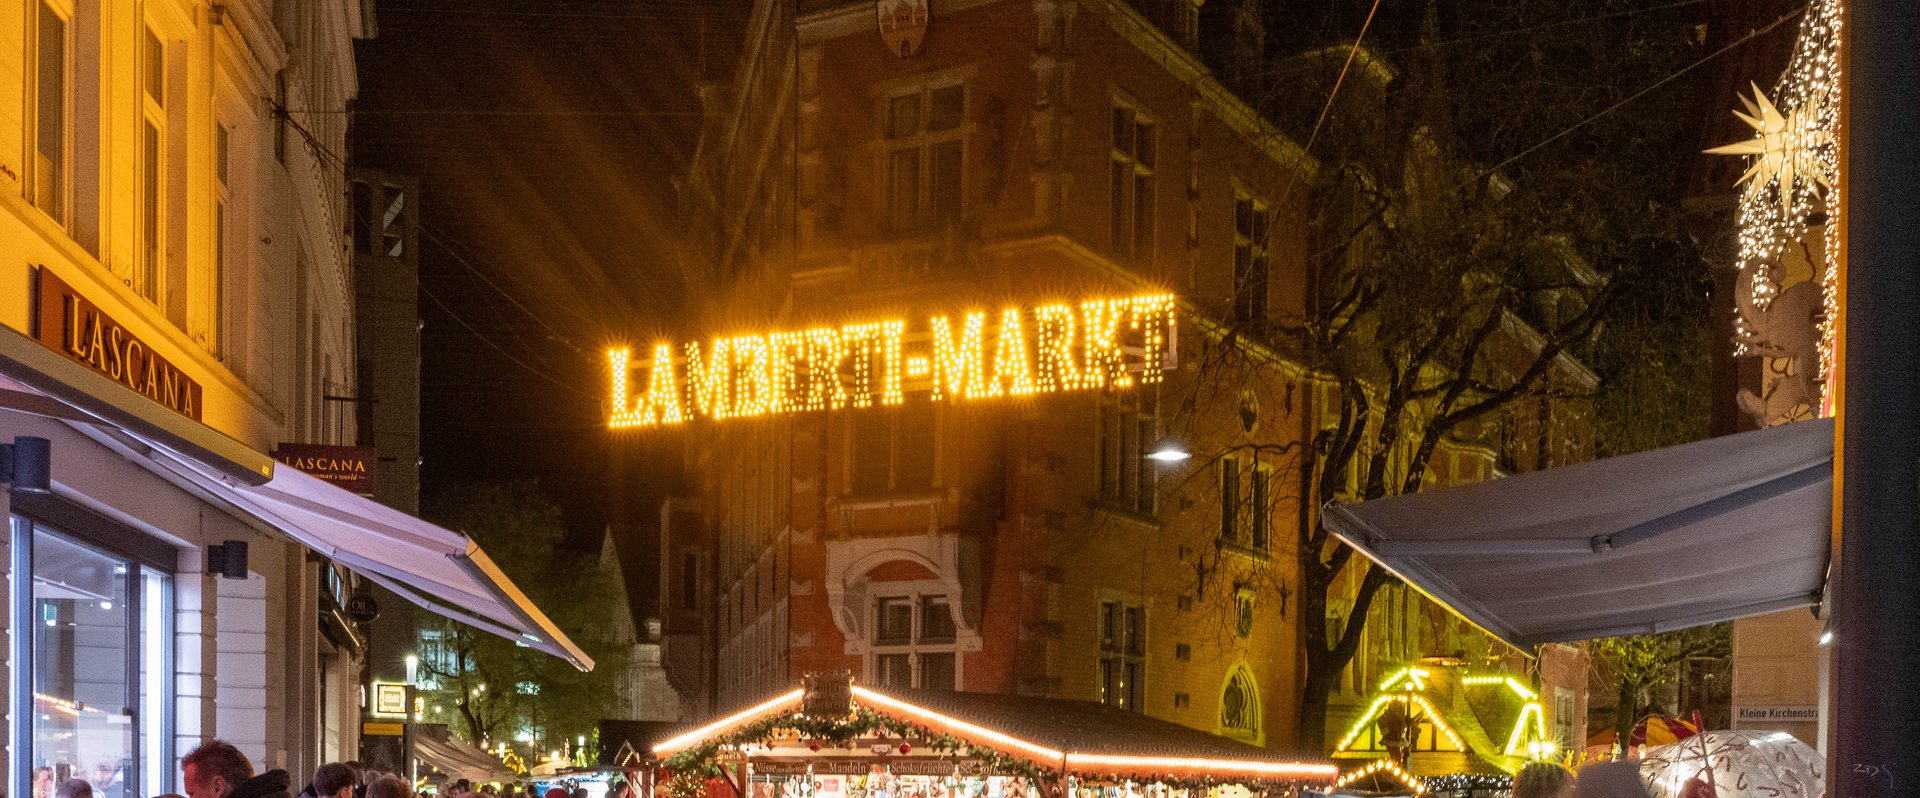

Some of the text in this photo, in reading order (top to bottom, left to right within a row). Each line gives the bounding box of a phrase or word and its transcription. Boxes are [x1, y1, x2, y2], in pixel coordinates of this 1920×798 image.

[72, 294, 193, 417] LASCANA
[609, 293, 1174, 427] LAMBERTI-MARKT
[1740, 708, 1766, 718] Kleine
[755, 762, 777, 773] Nüsse
[829, 761, 866, 774] Mandeln
[891, 761, 951, 774] Schokofrüchte
